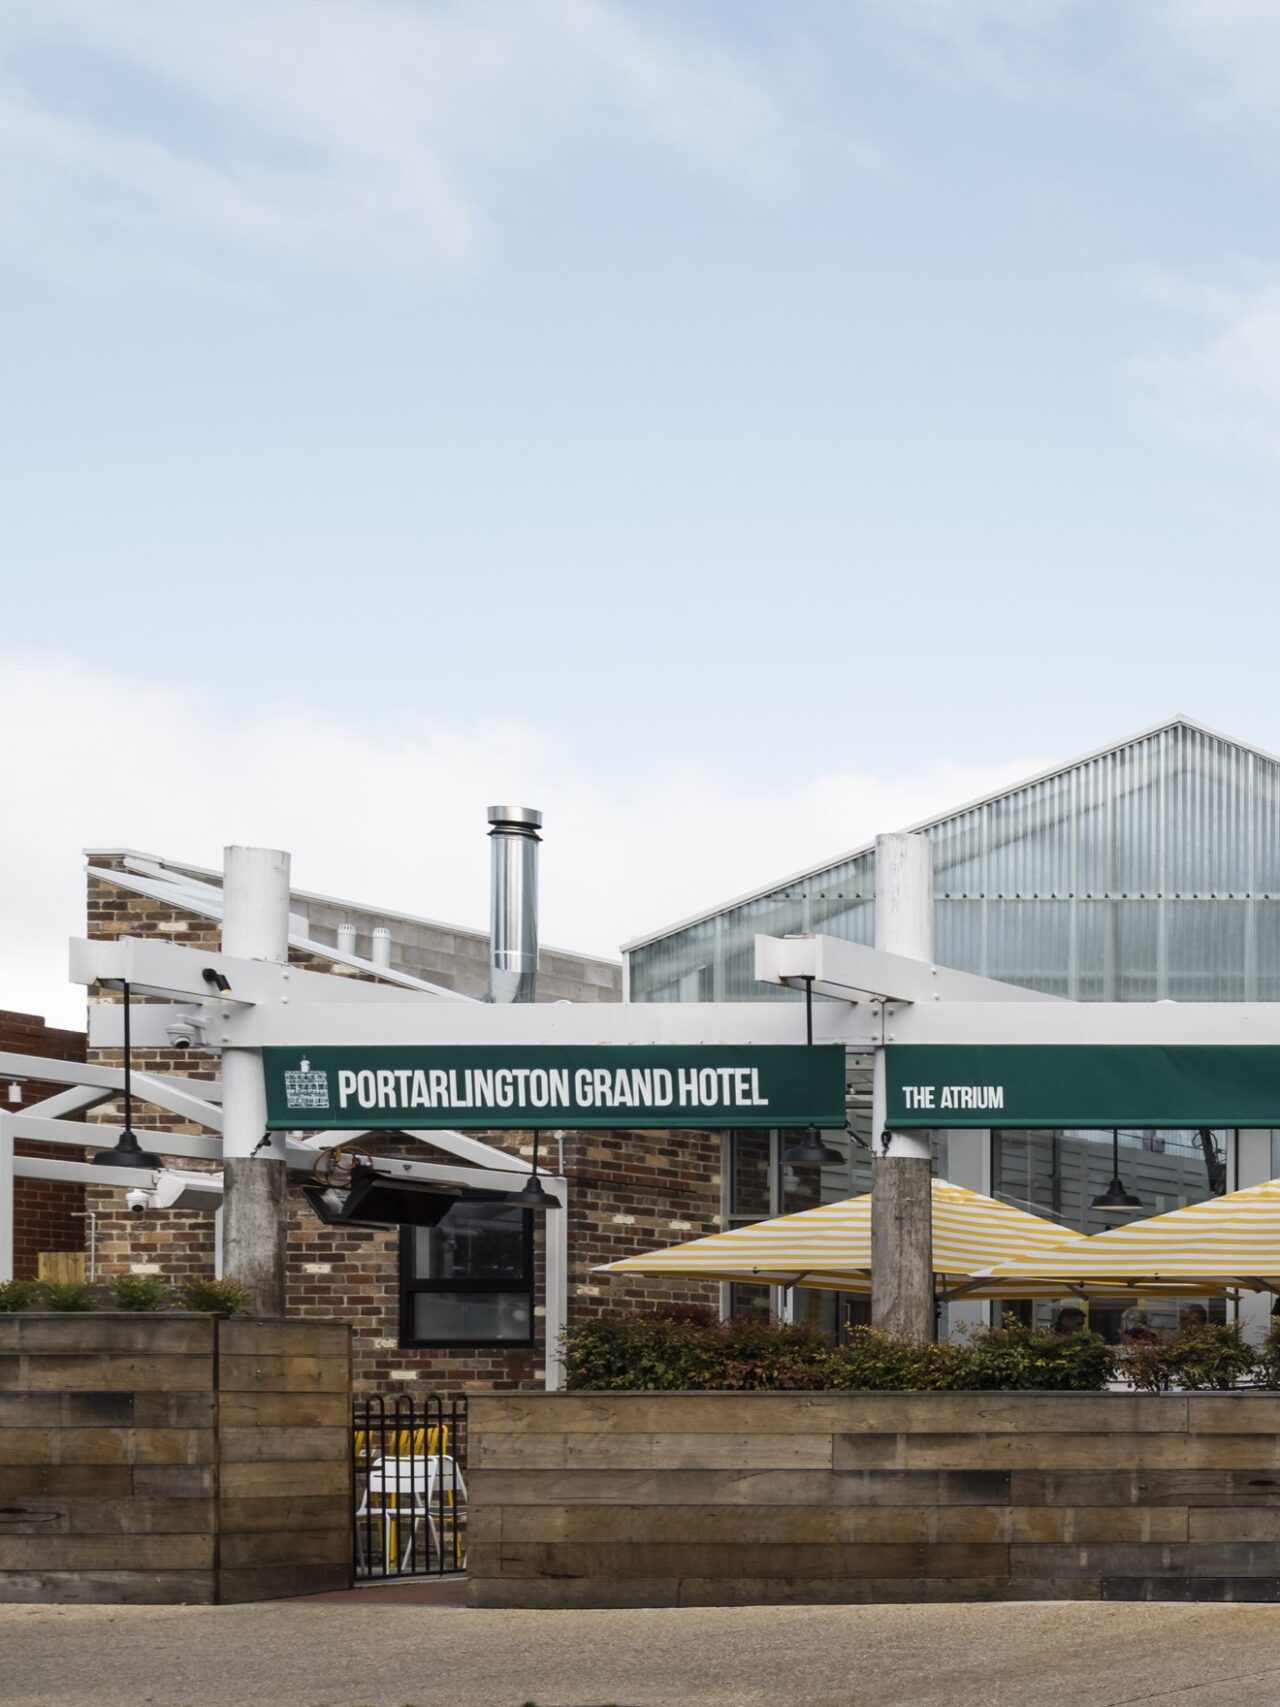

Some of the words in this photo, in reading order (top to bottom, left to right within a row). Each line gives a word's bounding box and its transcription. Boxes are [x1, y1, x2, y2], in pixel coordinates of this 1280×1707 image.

[338, 1069, 570, 1109] PORTARLINGTON
[574, 1068, 674, 1108] GRAND
[677, 1067, 770, 1107] HOTEL
[902, 1086, 936, 1109] THE
[940, 1085, 1004, 1109] ATRIUM
